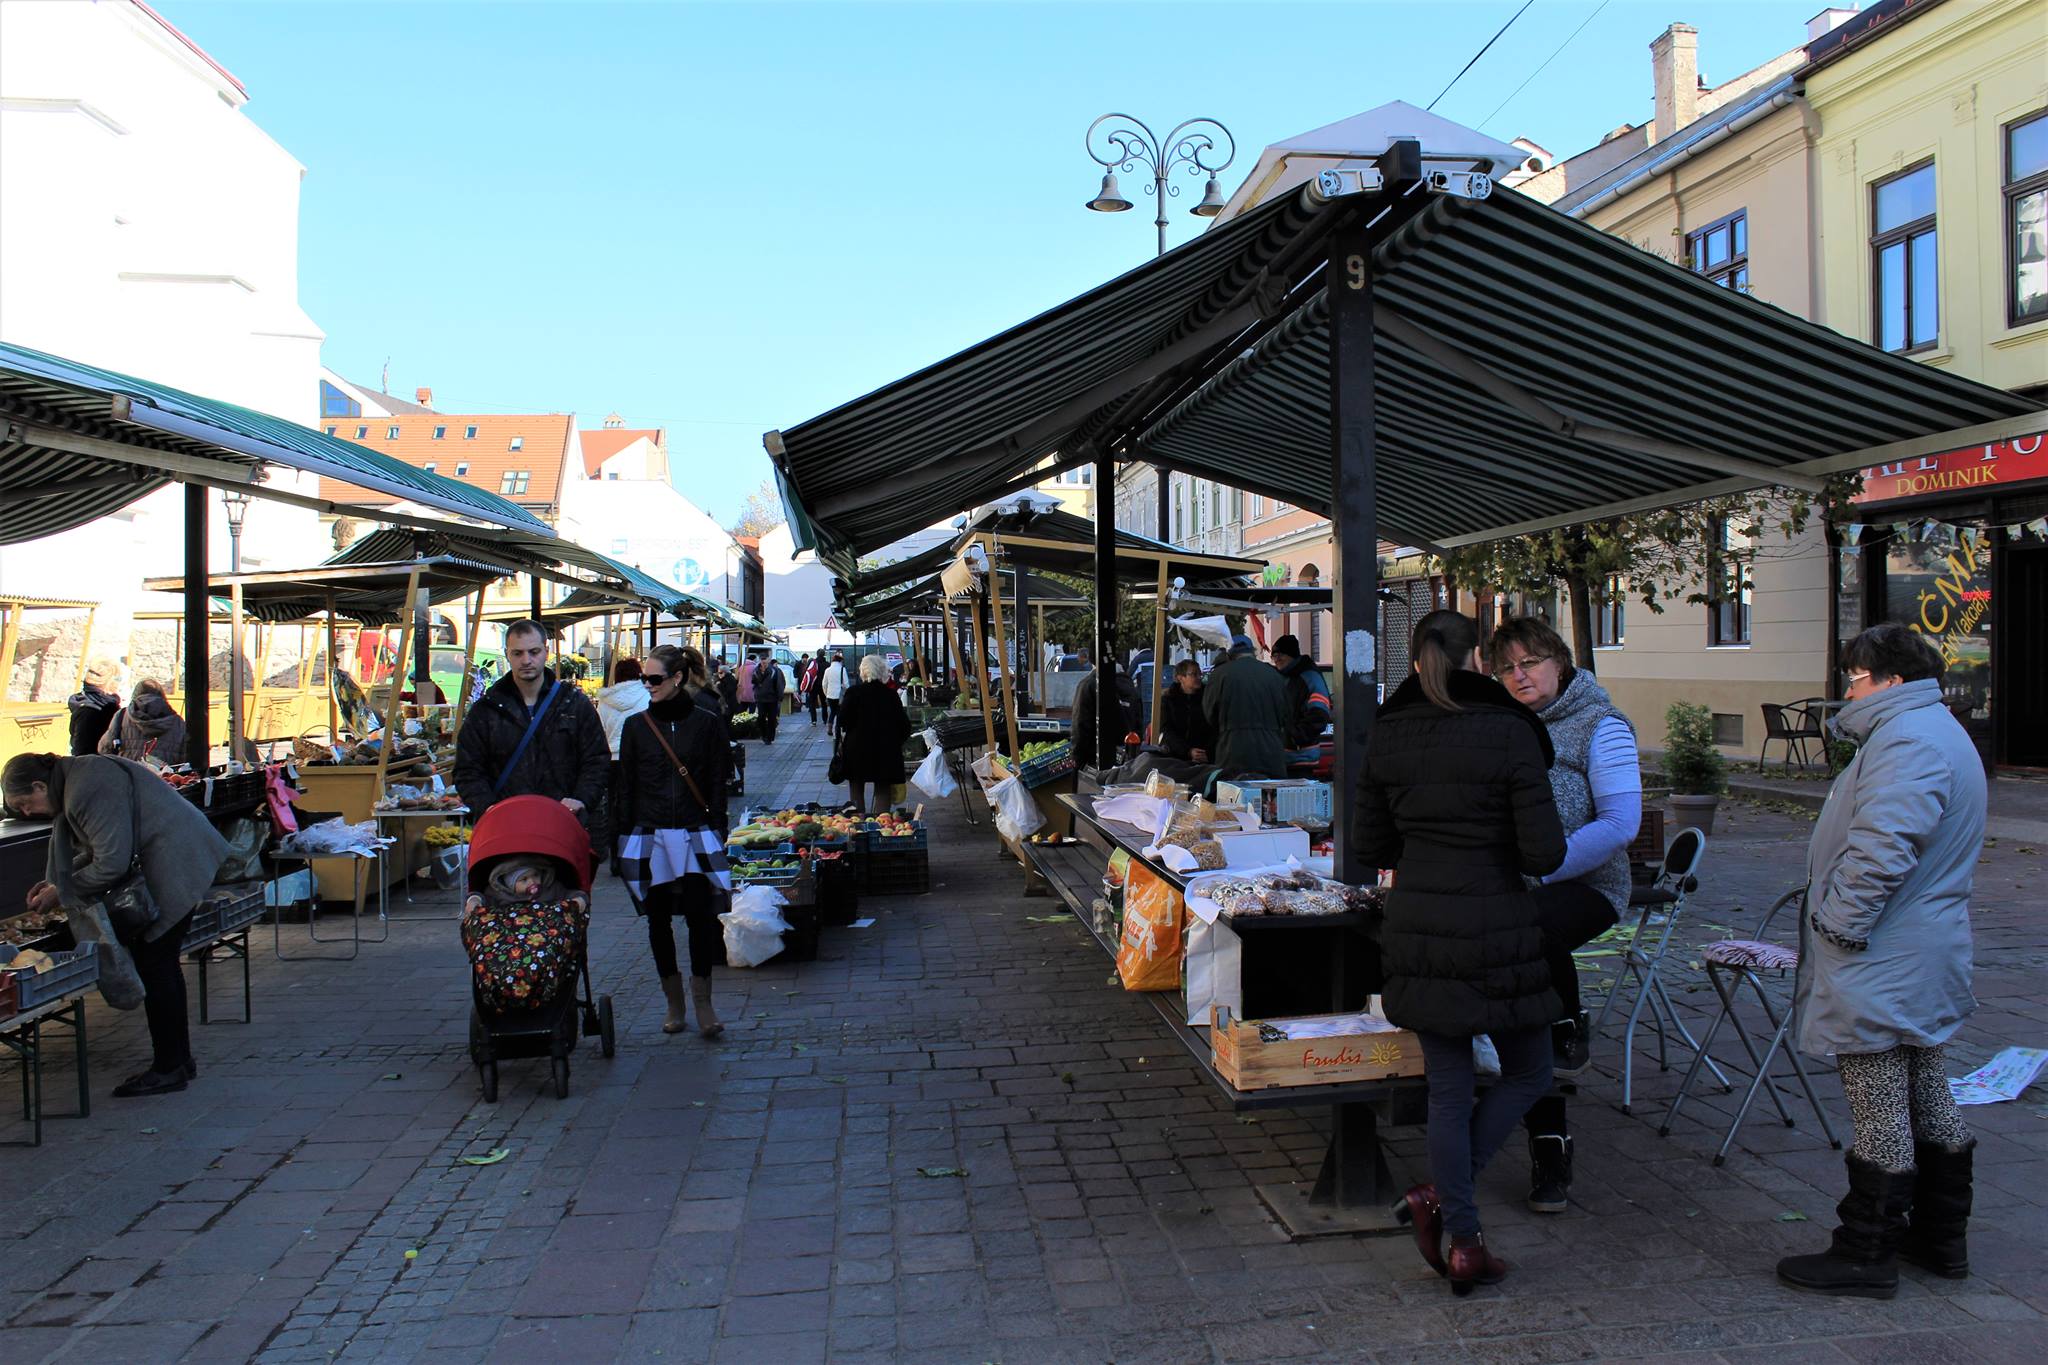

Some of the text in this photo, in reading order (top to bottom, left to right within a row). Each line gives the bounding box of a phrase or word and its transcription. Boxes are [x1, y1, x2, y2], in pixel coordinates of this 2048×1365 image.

[1346, 255, 1365, 289] 9
[1896, 464, 1997, 494] DOMINIK
[1940, 627, 1962, 672] ENY
[1303, 1046, 1361, 1069] Frudis
